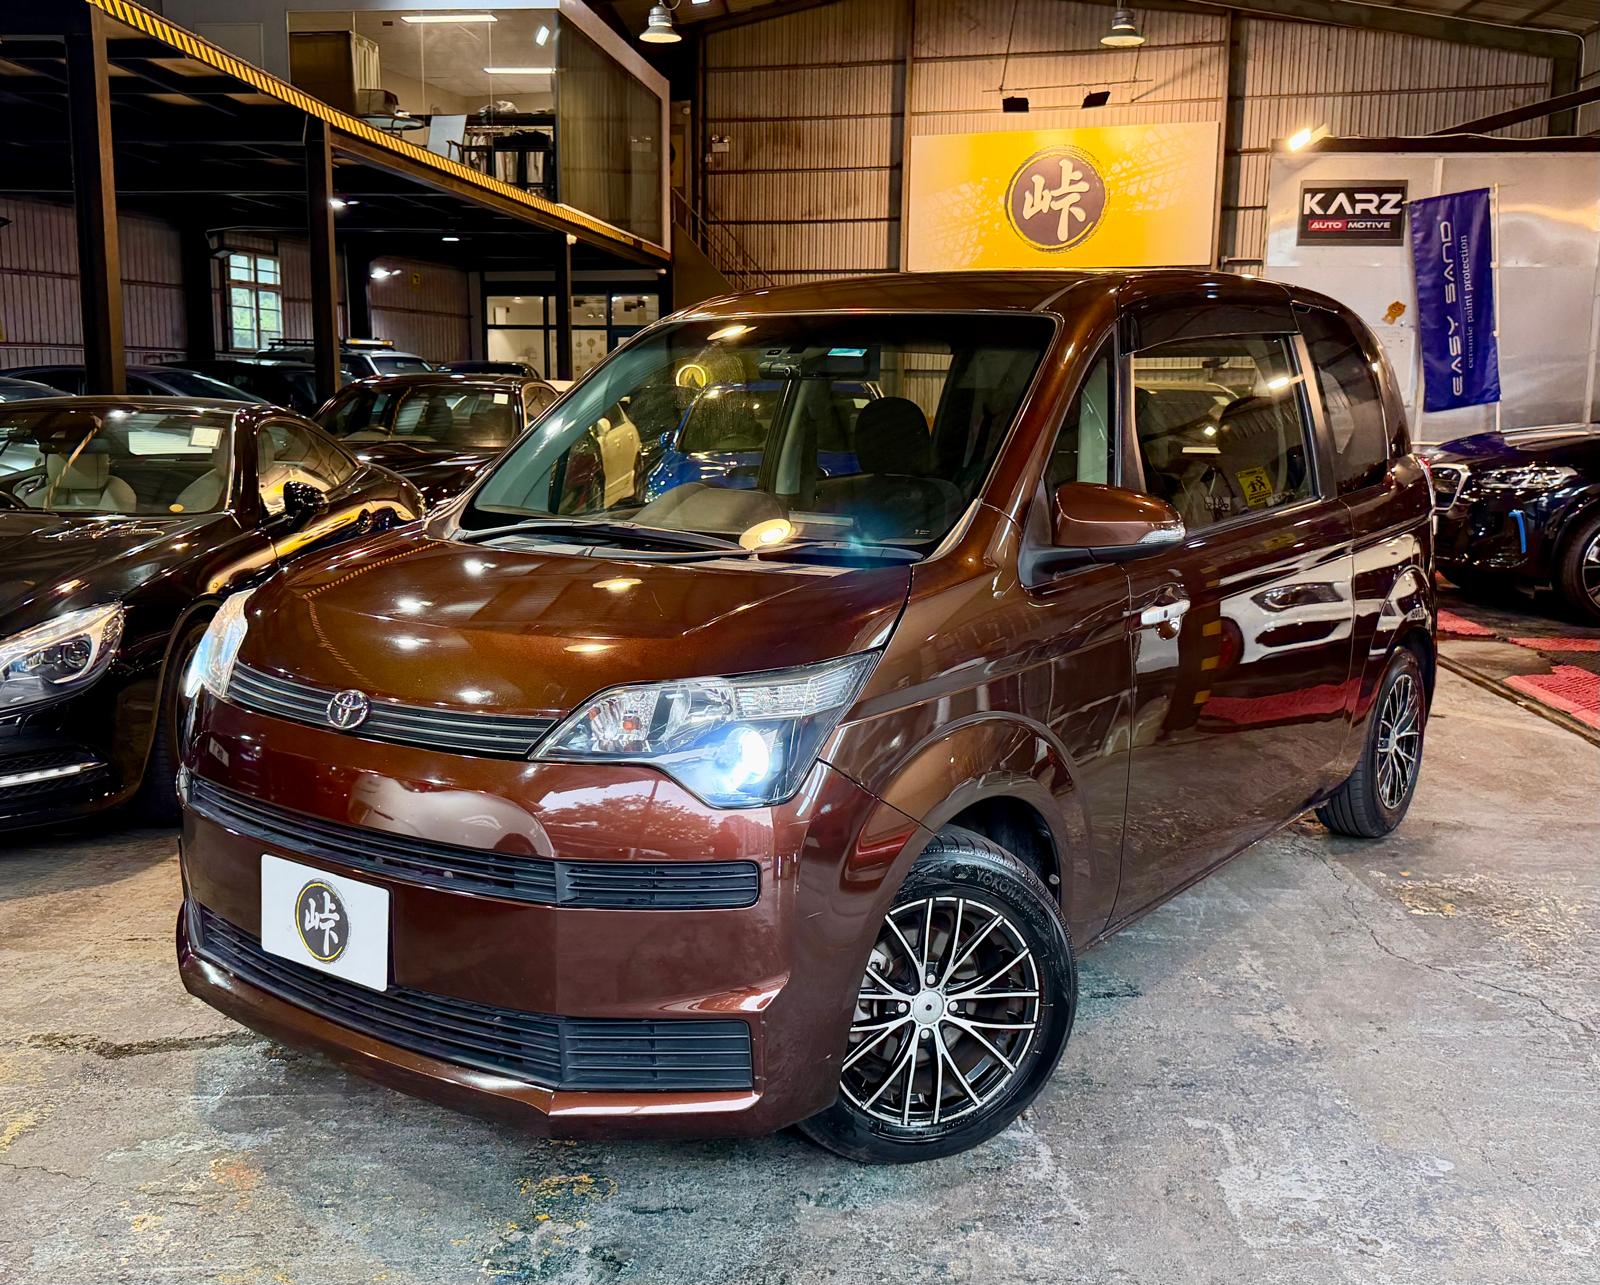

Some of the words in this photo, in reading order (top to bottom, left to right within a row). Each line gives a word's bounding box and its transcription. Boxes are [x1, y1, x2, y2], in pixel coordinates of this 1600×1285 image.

[1023, 159, 1090, 241] 峠
[1303, 192, 1402, 215] KARZ
[1311, 221, 1342, 229] AUTO
[1347, 221, 1391, 229] MOTIVE
[1440, 221, 1456, 304] SAND
[1460, 235, 1474, 291] protection
[1464, 295, 1474, 323] paint
[1446, 315, 1463, 396] EASY
[304, 891, 340, 956] 峠
